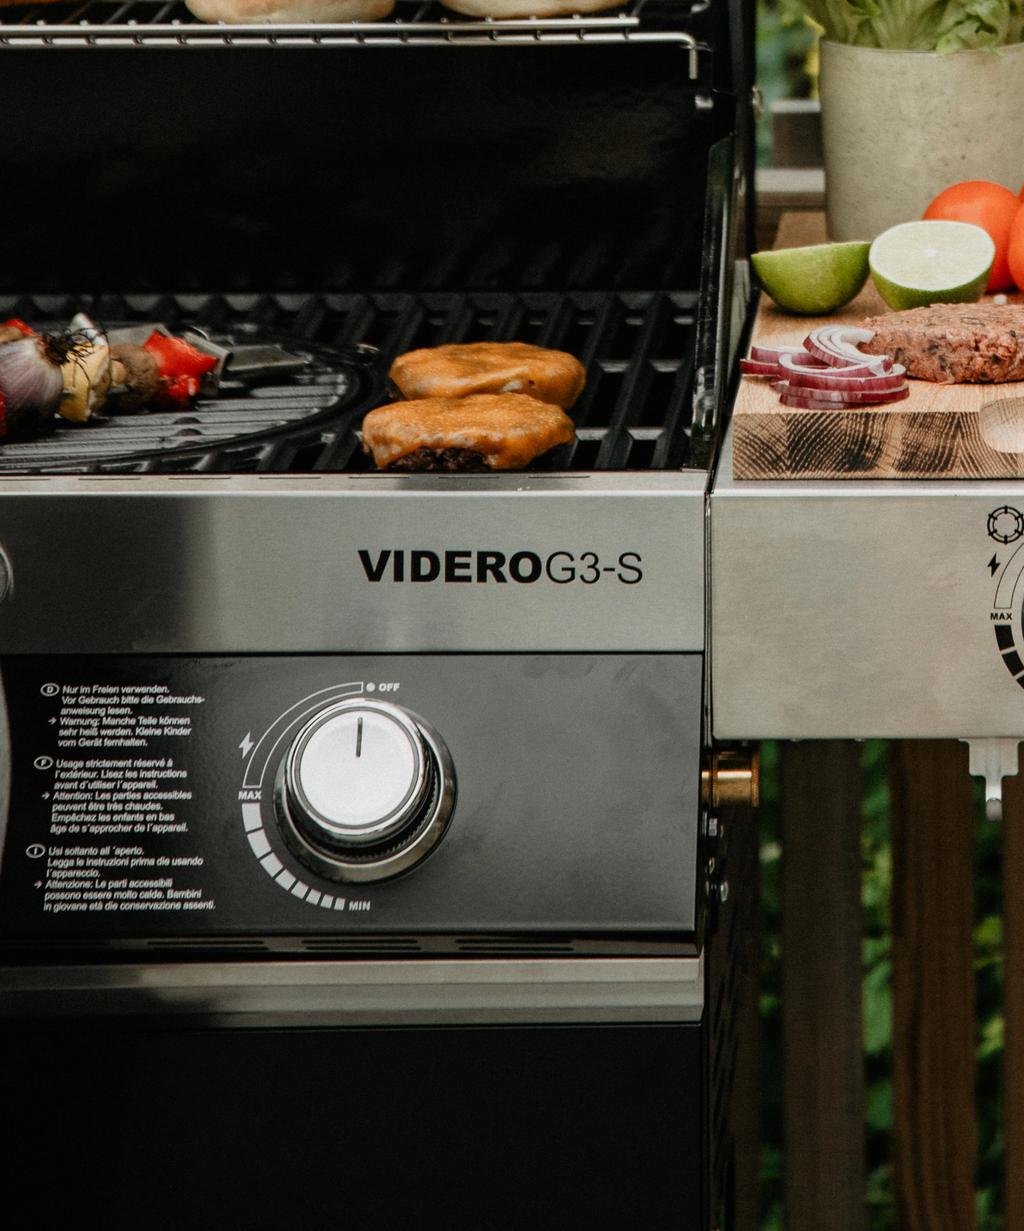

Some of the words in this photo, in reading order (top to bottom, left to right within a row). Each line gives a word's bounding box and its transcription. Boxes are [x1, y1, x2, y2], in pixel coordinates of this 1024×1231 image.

[63, 686, 78, 694] Nur
[92, 685, 119, 693] Freien
[121, 685, 169, 693] verwenden.
[379, 683, 400, 691] OFF
[62, 696, 76, 704] Vor
[78, 696, 119, 704] Gebrauch
[121, 696, 139, 704] bitte
[156, 695, 205, 704] Gebrauchs-
[61, 706, 105, 716] anweisung
[60, 717, 100, 726] Warnung:
[102, 717, 136, 725] Manche
[138, 717, 157, 725] Teile
[159, 716, 190, 725] können
[59, 728, 77, 736] sehr
[80, 728, 98, 736] heiß
[101, 728, 133, 736] werden.
[136, 727, 162, 736] Kleine
[164, 727, 192, 735] Kinder
[78, 738, 102, 747] Gerät
[104, 738, 148, 746] fernhalten.
[56, 760, 83, 769] Usage
[86, 759, 132, 768] strictement
[134, 759, 165, 767] réservé
[101, 769, 123, 778] Lisez
[125, 769, 137, 778] les
[140, 769, 187, 778] instructions
[54, 781, 78, 789] avant
[53, 791, 93, 800] Attention:
[95, 791, 110, 800] Les
[113, 791, 141, 801] parties
[143, 791, 192, 799] accessibles
[238, 791, 262, 800] MAX
[52, 802, 86, 812] peuvent
[125, 802, 163, 810] chaudes.
[98, 813, 110, 821] les
[113, 813, 144, 821] enfants
[159, 812, 175, 821] bas
[69, 824, 79, 832] de
[134, 824, 145, 832] de
[49, 847, 62, 855] Usi
[65, 847, 98, 856] soltanto
[48, 859, 74, 868] Legga
[77, 858, 84, 866] le
[86, 858, 128, 866] instruzioni
[131, 858, 155, 868] prima
[157, 857, 170, 865] die
[172, 856, 203, 865] usando
[45, 880, 93, 889] Attenzione:
[96, 880, 107, 888] Le
[108, 879, 127, 889] parti
[129, 879, 172, 887] accessibili
[45, 891, 81, 901] possono
[83, 891, 112, 899] essere
[114, 890, 137, 899] molto
[139, 890, 164, 899] calde.
[167, 890, 202, 899] Bambini
[44, 902, 52, 911] in
[53, 902, 87, 913] giovane
[120, 901, 181, 910] conservazione
[183, 900, 216, 910] assenti.
[349, 901, 370, 911] MIN
